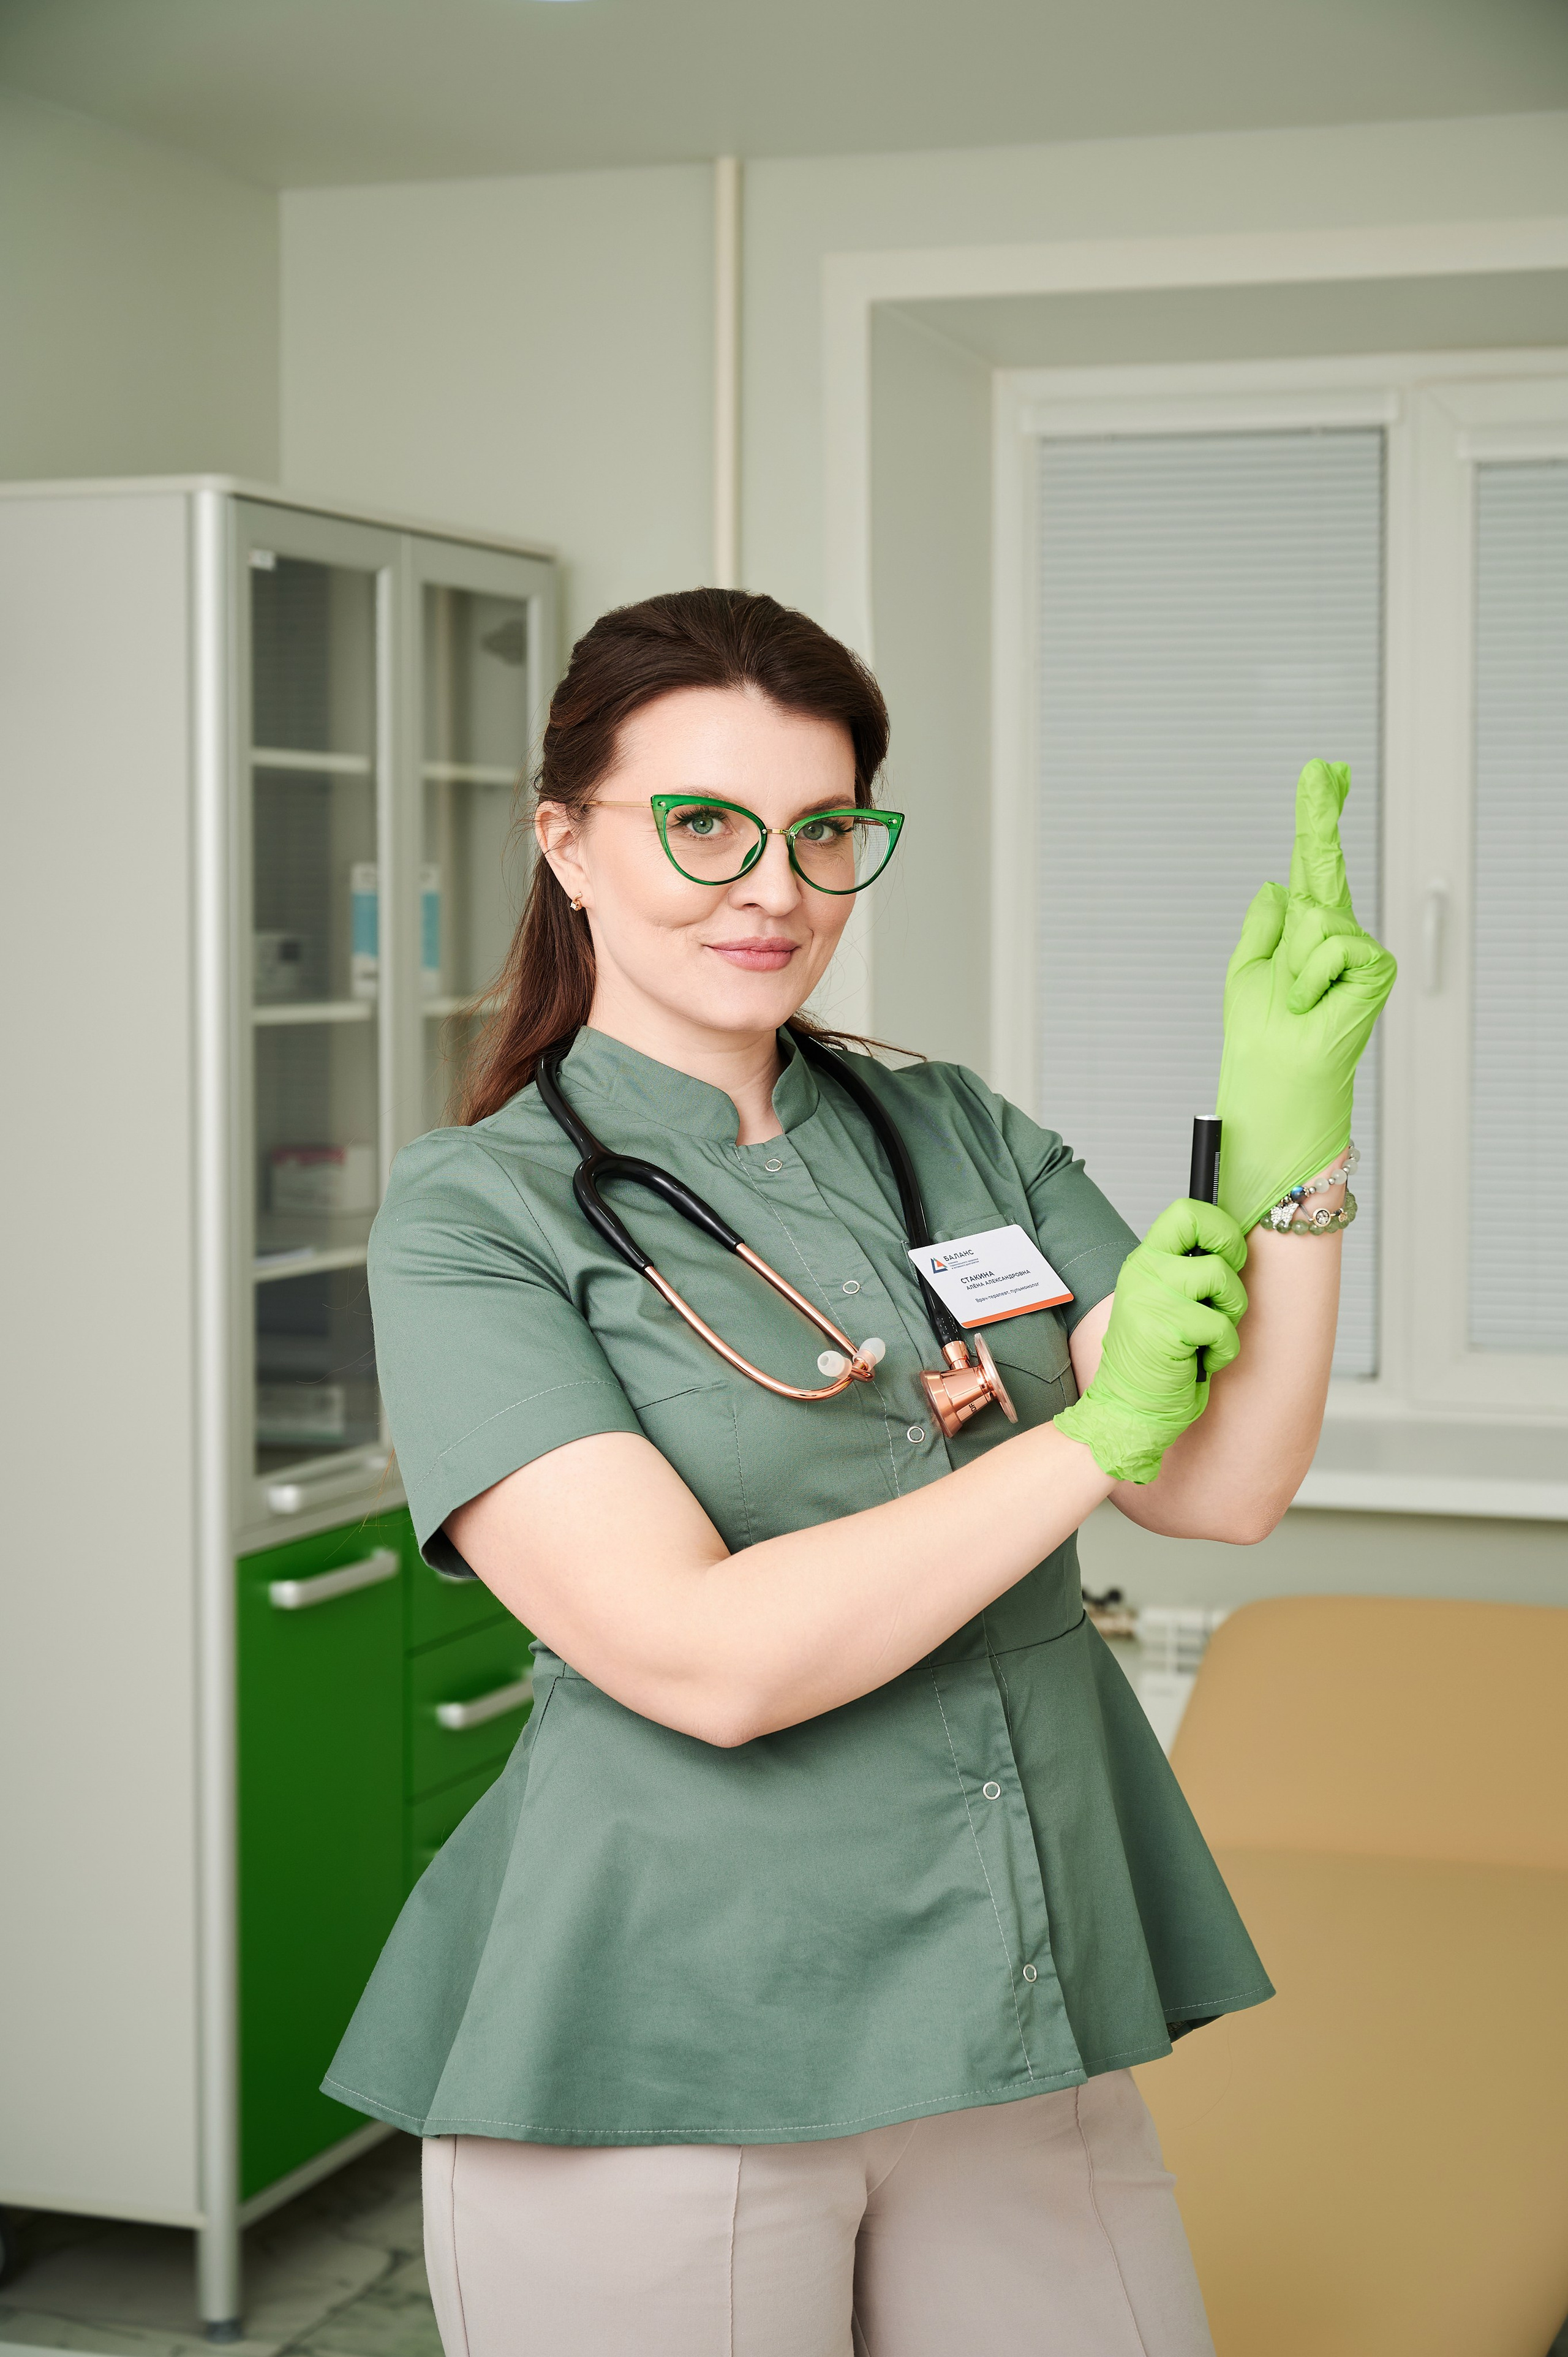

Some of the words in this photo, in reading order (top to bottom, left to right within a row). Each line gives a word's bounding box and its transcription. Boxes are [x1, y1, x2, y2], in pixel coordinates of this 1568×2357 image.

[943, 1249, 974, 1261] БАЛАНС
[960, 1270, 995, 1284] СТАКИНА
[985, 1269, 1031, 1286] АЛЕКСАНДРОВНА
[975, 1290, 1011, 1303] Врач-терапевт,
[1010, 1282, 1040, 1294] пульмонолог
[968, 1403, 978, 1414] DF
